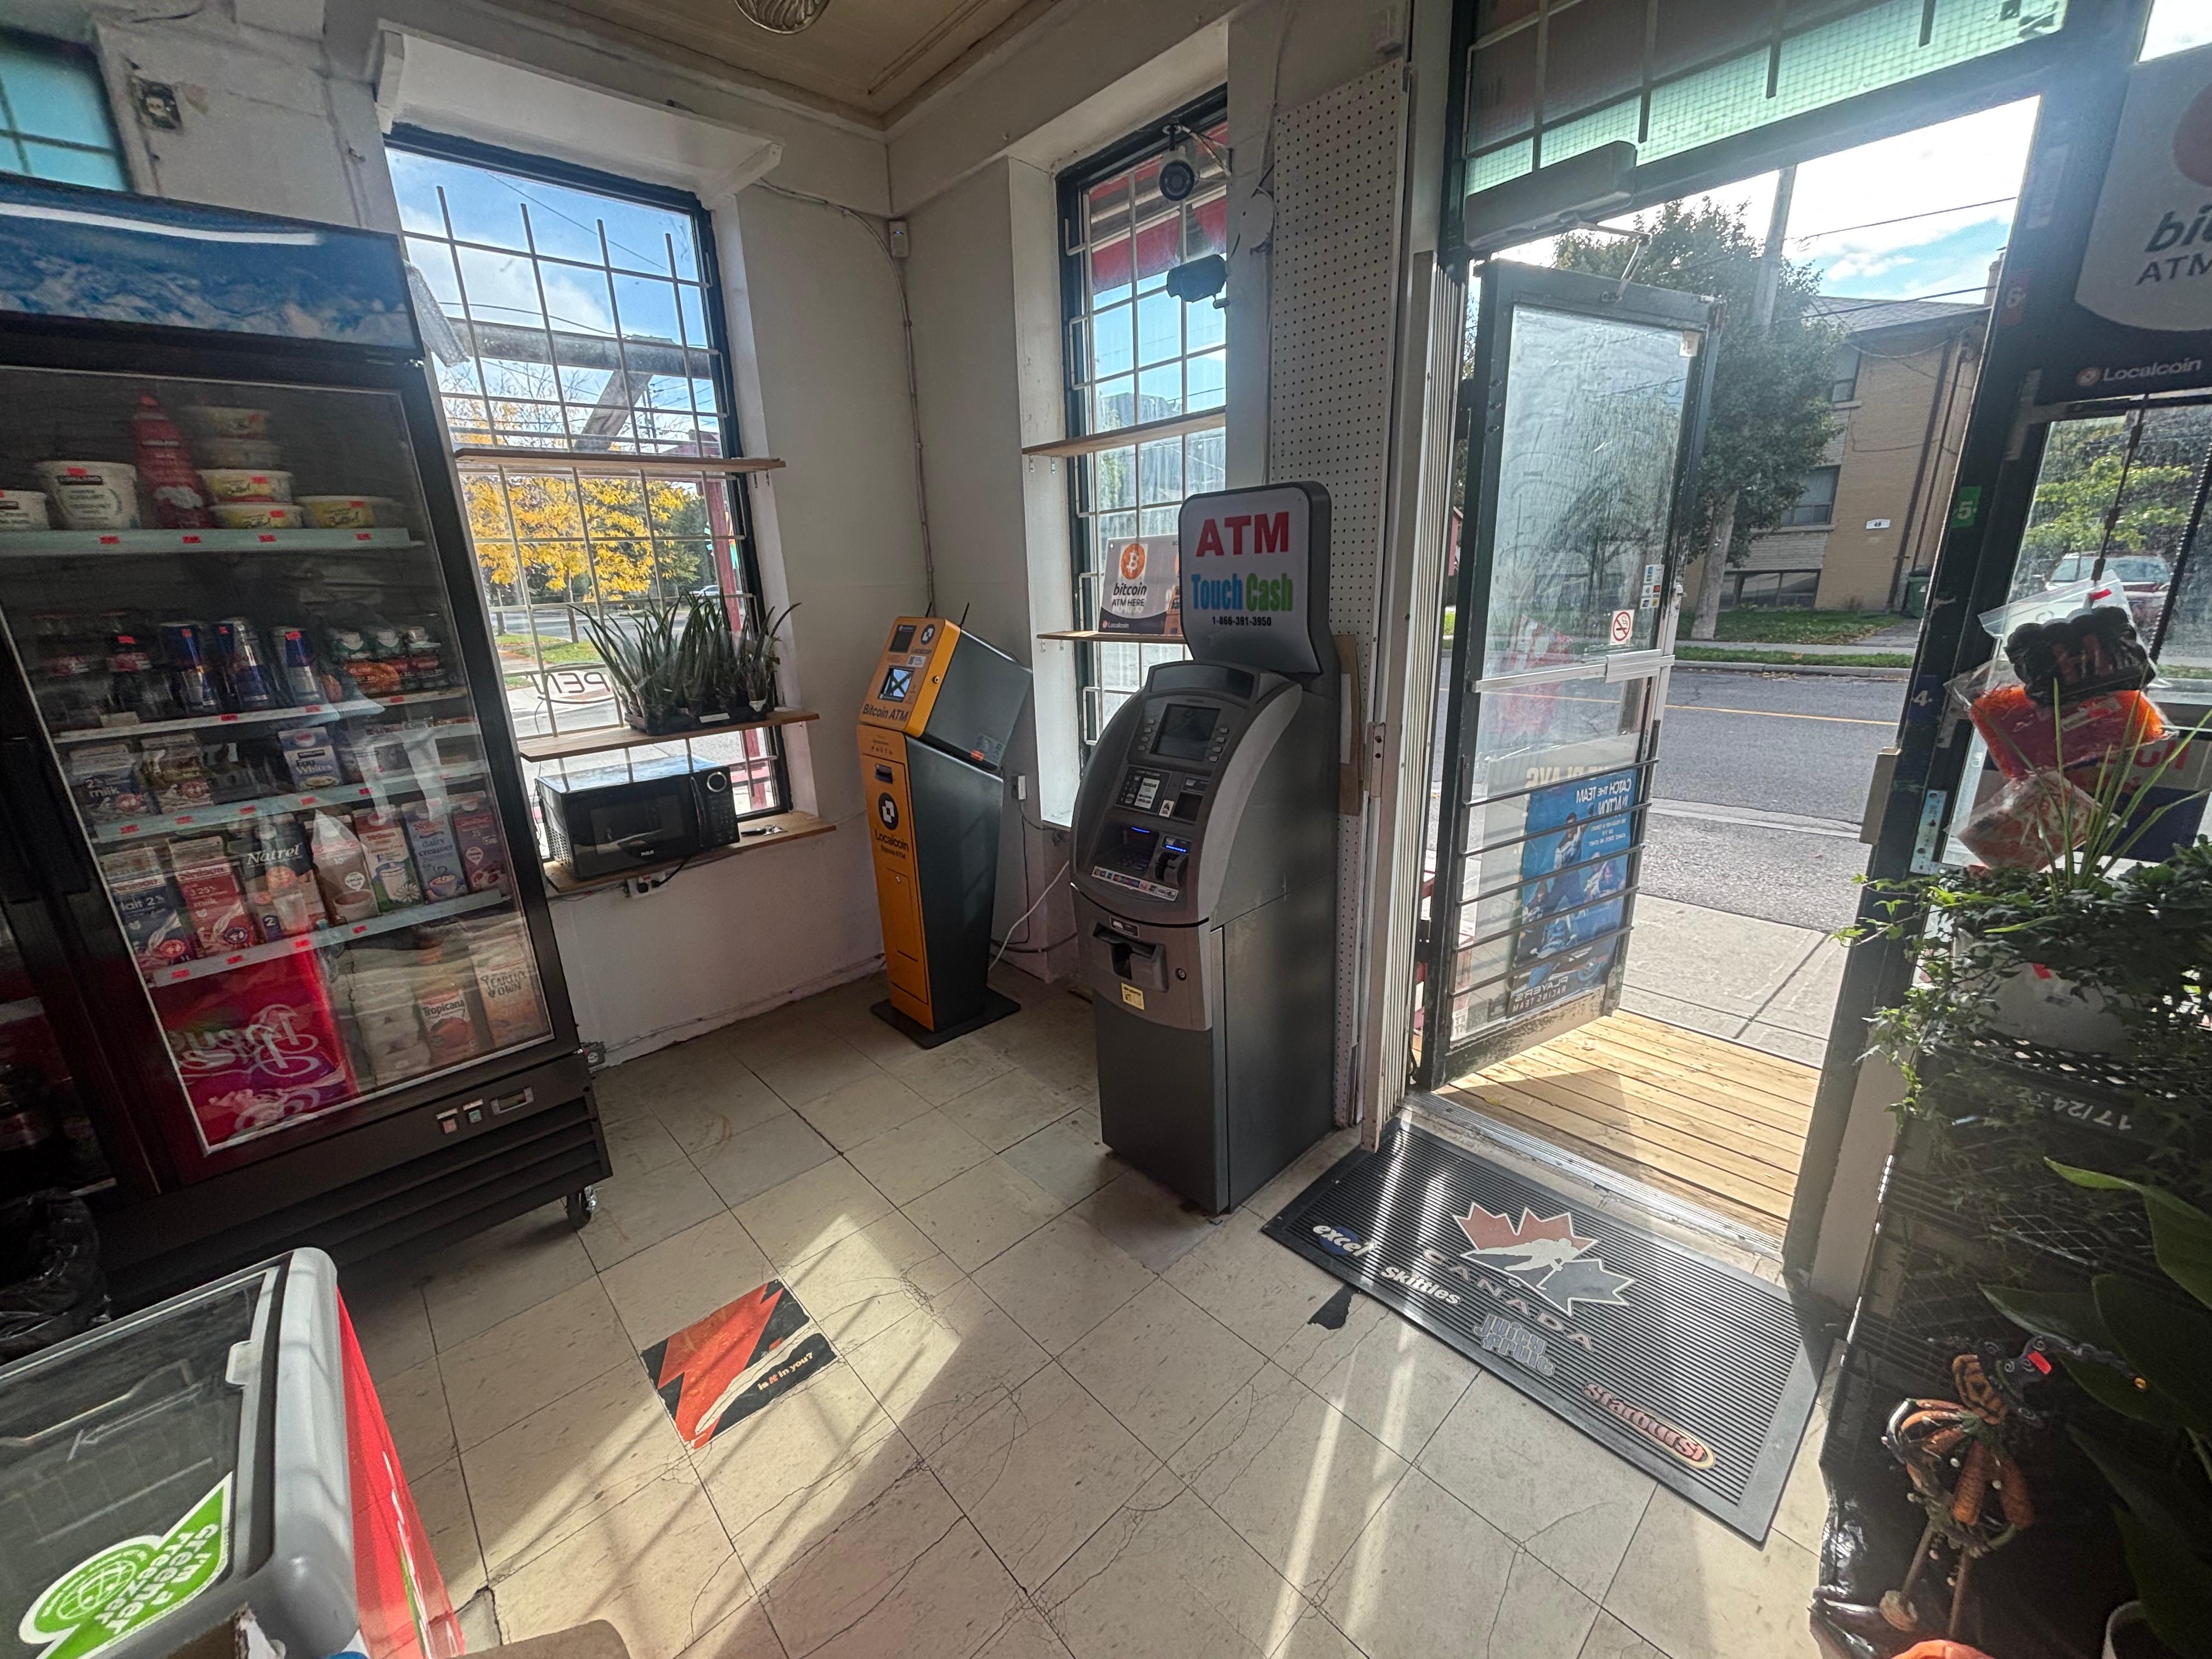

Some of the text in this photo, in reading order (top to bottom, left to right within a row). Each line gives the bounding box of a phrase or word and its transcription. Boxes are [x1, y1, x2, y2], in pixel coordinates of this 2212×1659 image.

[2103, 358, 2202, 381] Localcoin
[1195, 511, 1289, 557] ATM
[1113, 582, 1147, 596] bitcoin
[1111, 599, 1145, 607] ATM HERE
[1211, 616, 1272, 627] 1-866-391-3950
[1913, 690, 1929, 707] 4
[862, 704, 910, 722] Bitcoin ATM
[422, 836, 445, 848] dairy
[874, 828, 909, 851] Localcoin
[246, 842, 303, 865] Natrel
[418, 844, 454, 856] creamer
[264, 917, 276, 927] 2
[421, 999, 465, 1015] Tropicana
[1313, 1224, 1376, 1257] excel
[1380, 1266, 1462, 1305] Skittles
[1423, 1249, 1593, 1352] CANADA
[778, 1368, 789, 1378] in
[789, 1351, 814, 1372] you?
[1583, 1383, 1707, 1462] Starburst
